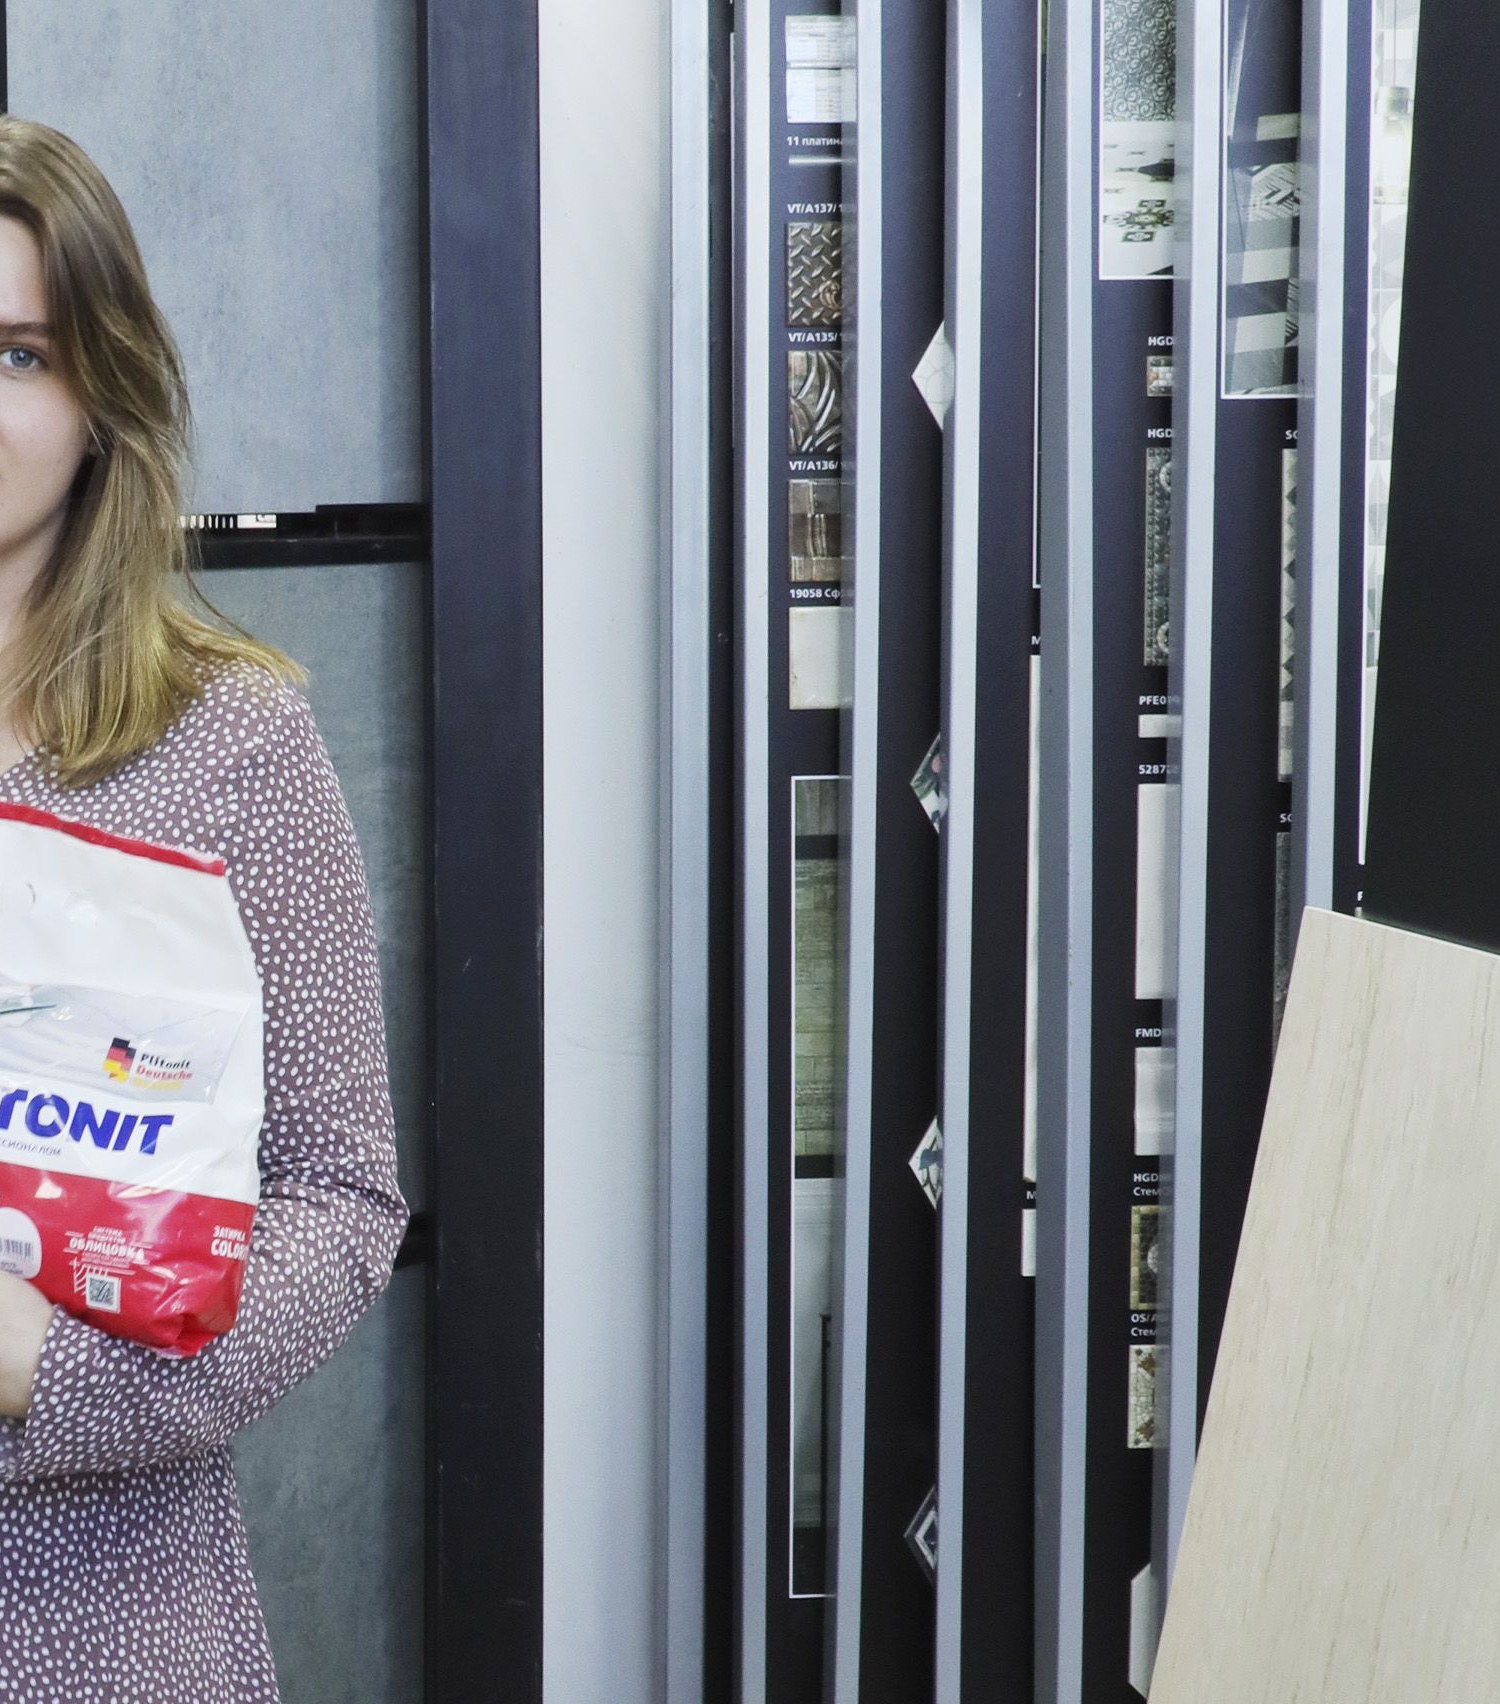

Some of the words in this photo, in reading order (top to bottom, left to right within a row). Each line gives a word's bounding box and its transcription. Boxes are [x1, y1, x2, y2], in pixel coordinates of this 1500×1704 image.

[786, 136, 799, 146] 11
[787, 203, 842, 214] VT/A137/
[788, 332, 842, 342] VT/A135/
[789, 588, 823, 599] 19058
[824, 588, 841, 600] Сф
[1139, 695, 1167, 706] PFE0
[1138, 764, 1167, 775] 5287
[139, 1053, 191, 1069] Plitonit
[136, 1065, 194, 1080] Deutsche
[1133, 1186, 1160, 1196] Стем
[68, 1237, 148, 1265] ОБЛИЦОВКА
[211, 1238, 249, 1261] COLOR
[1131, 1327, 1156, 1337] Стем
